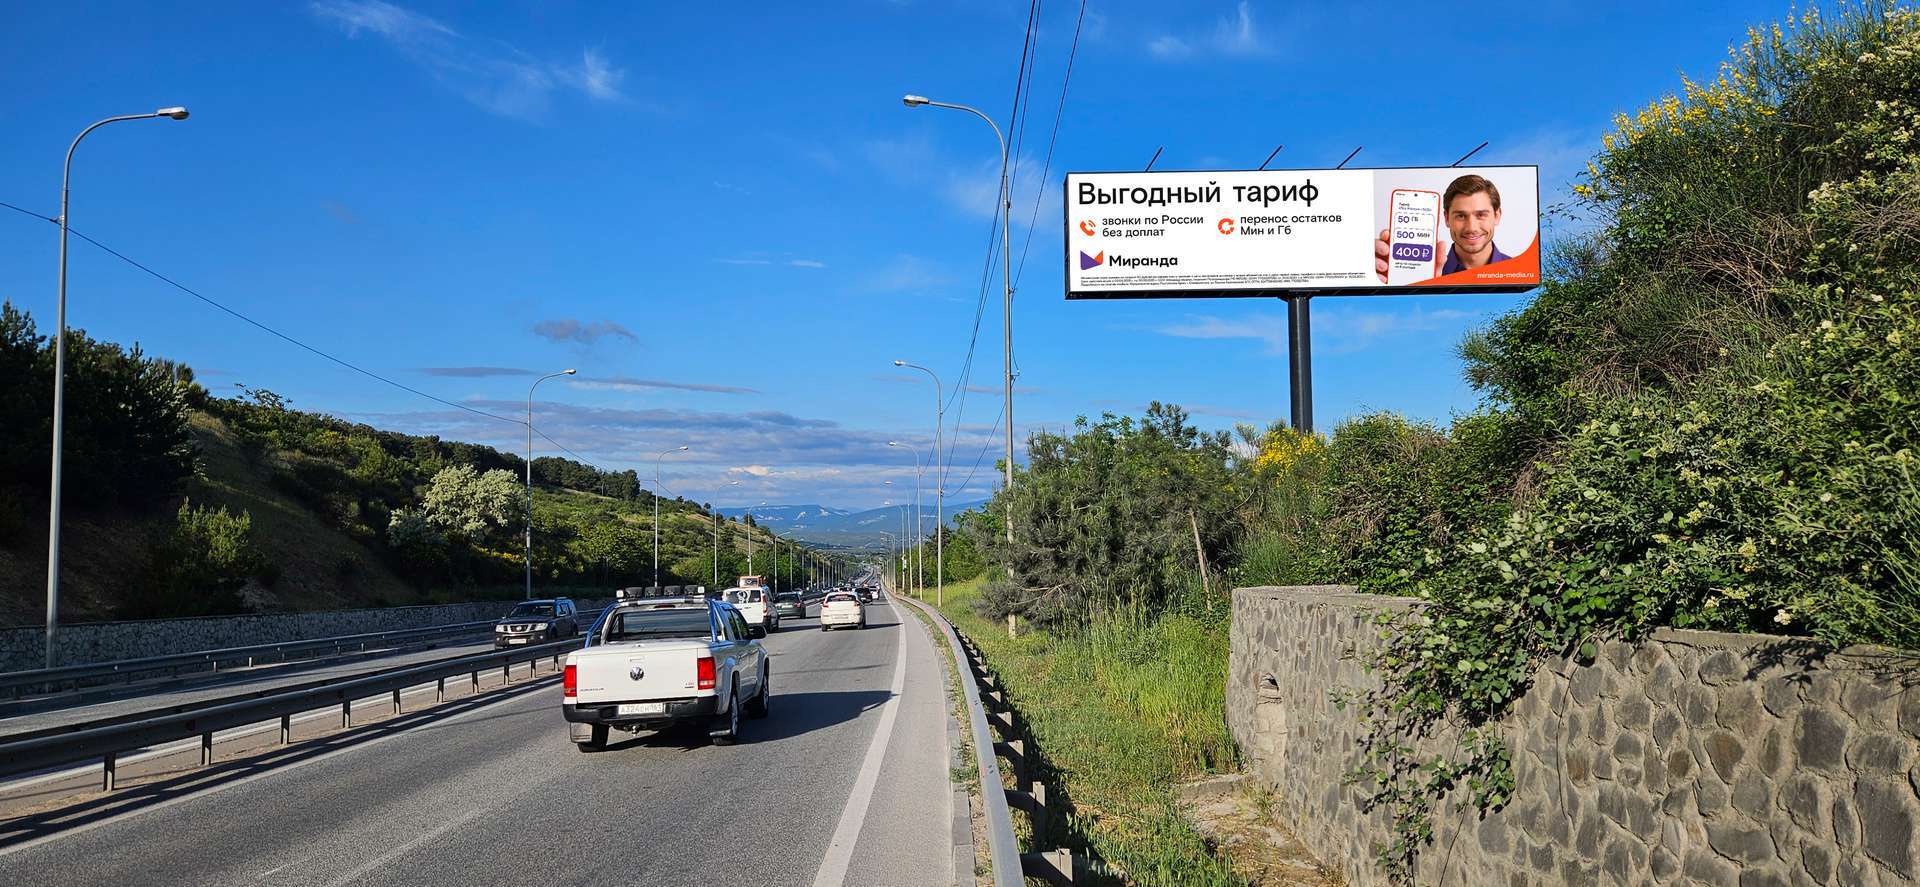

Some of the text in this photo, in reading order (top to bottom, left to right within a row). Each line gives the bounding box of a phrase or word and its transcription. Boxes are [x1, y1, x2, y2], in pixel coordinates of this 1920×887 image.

[1078, 178, 1319, 207] Выгодный тариф
[1102, 214, 1204, 226] звонки по России
[1240, 214, 1342, 225] перенос остатков
[1398, 215, 1410, 223] 50
[1102, 227, 1165, 238] без доплат
[1240, 225, 1292, 236] Мин и Гб
[1396, 231, 1415, 239] 500
[1395, 247, 1420, 258] 400
[1109, 255, 1178, 269] Миранда
